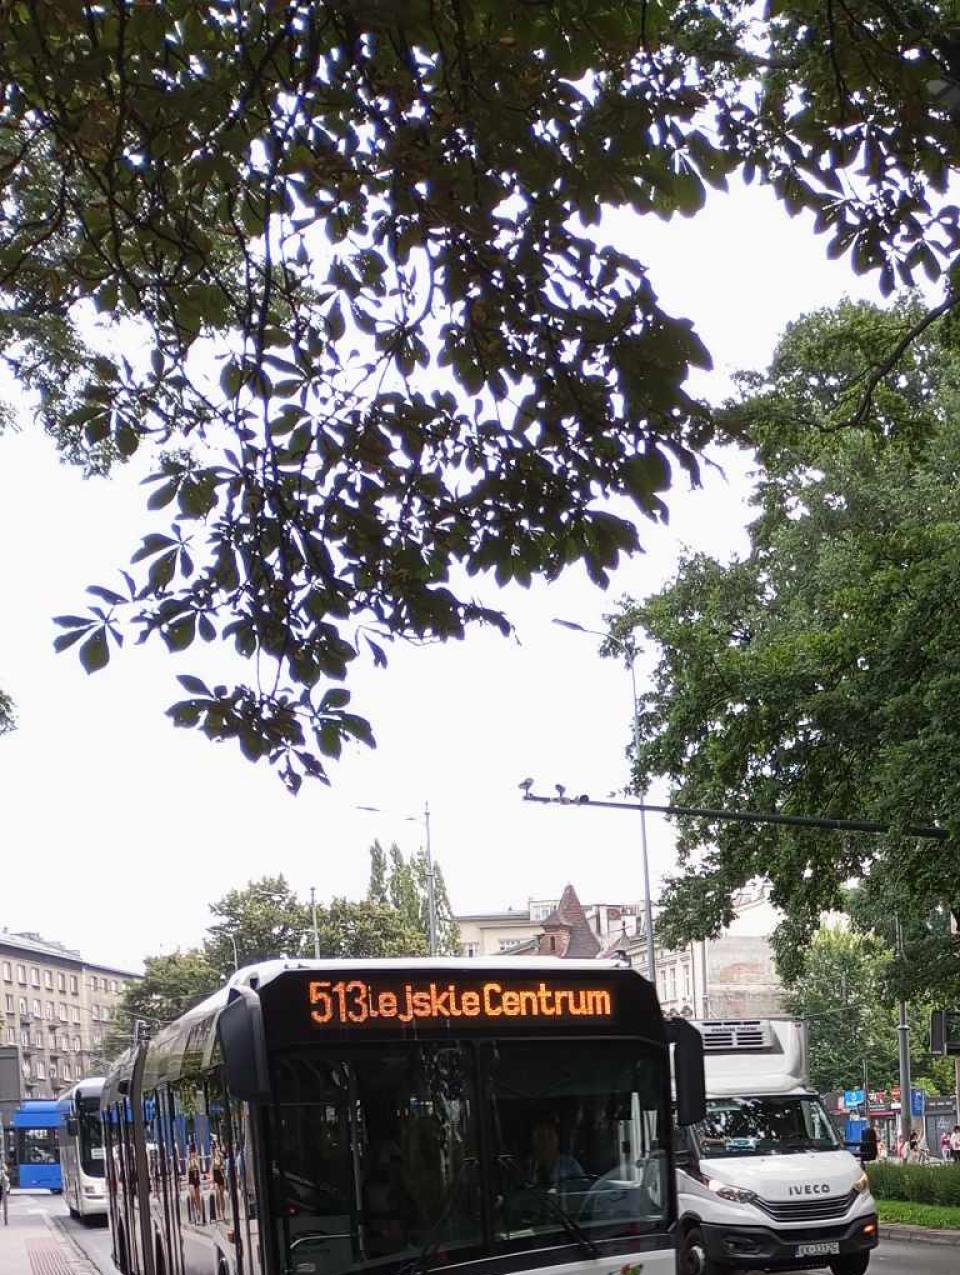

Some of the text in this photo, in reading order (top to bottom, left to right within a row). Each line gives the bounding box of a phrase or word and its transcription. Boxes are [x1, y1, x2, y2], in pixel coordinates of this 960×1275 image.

[309, 980, 368, 1023] 513
[484, 983, 611, 1017] Centrum
[789, 1184, 831, 1197] IVECO
